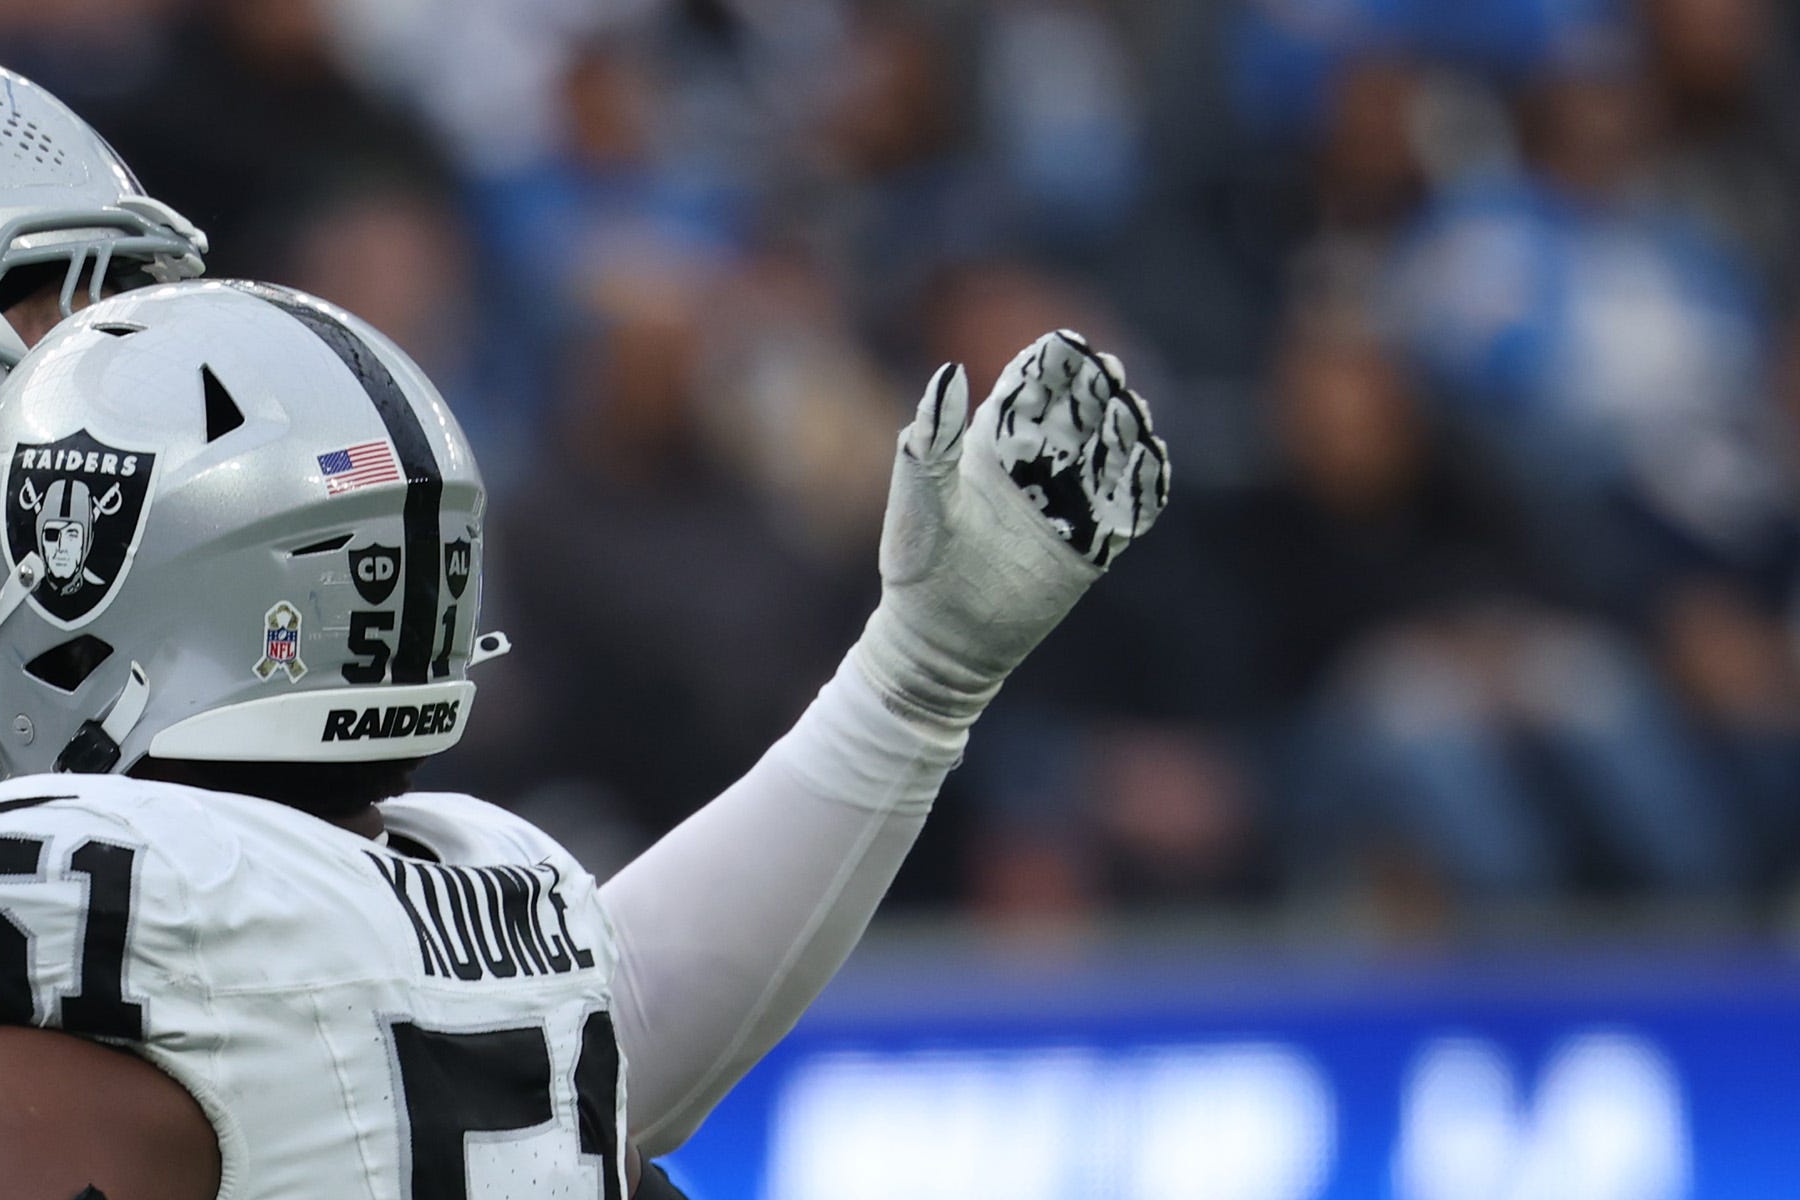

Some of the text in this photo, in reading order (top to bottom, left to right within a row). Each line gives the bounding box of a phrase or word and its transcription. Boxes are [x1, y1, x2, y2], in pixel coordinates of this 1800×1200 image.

[21, 447, 138, 477] RAIDERS
[357, 556, 394, 583] CD
[449, 550, 469, 576] AL
[270, 642, 294, 659] NFL
[321, 699, 460, 743] RAIDERS
[360, 849, 595, 982] KOUNCE
